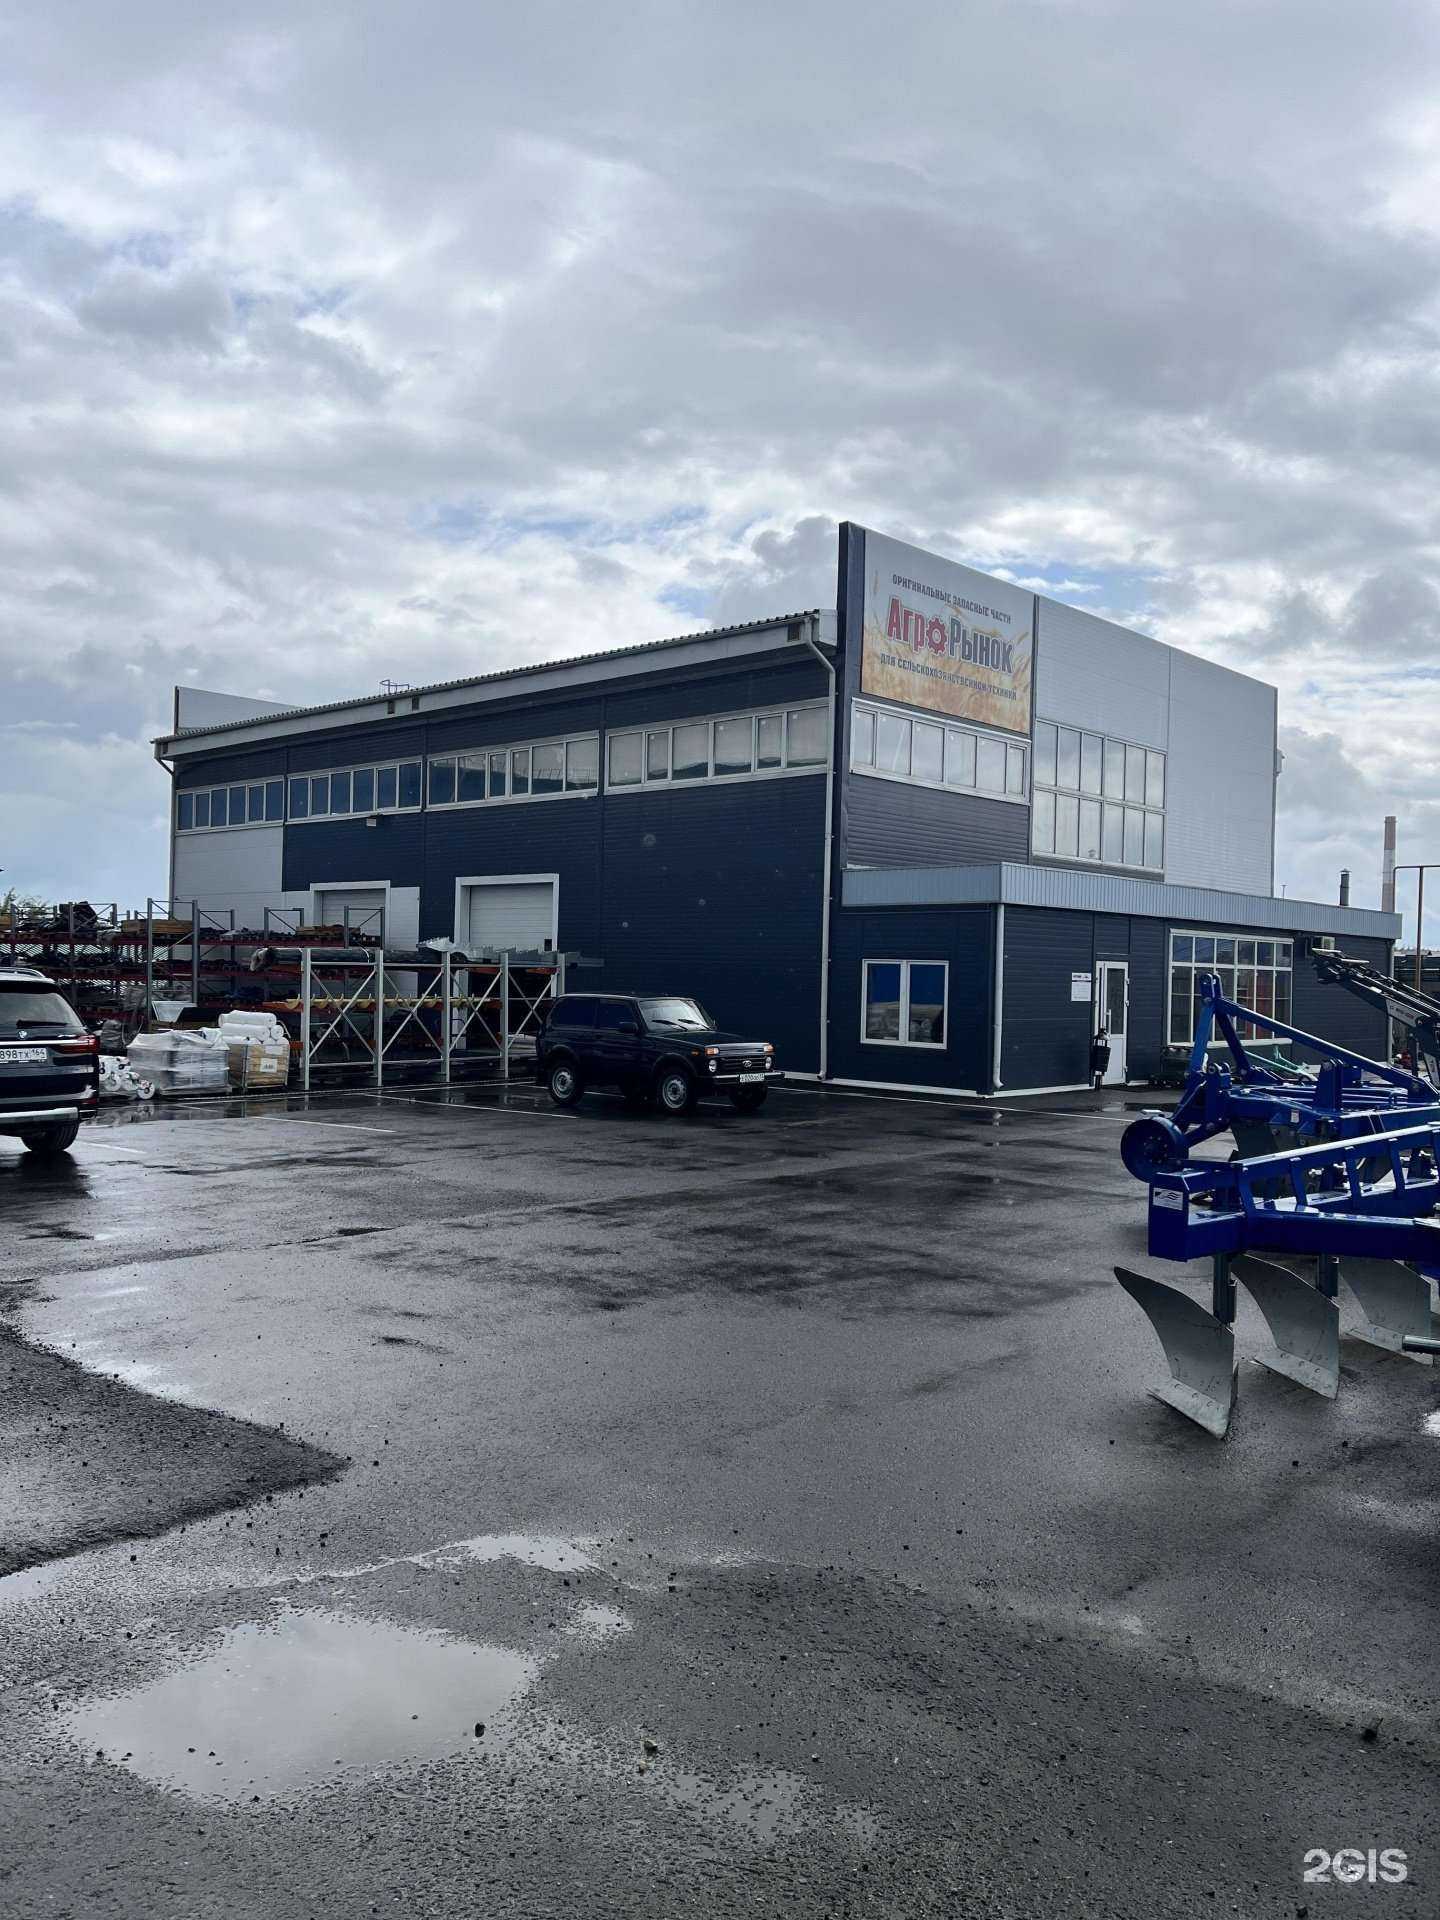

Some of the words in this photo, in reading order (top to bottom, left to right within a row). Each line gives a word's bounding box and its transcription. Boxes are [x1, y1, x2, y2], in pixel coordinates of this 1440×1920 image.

[892, 574, 951, 604] ОРИГИНАЛЬНЫЕ
[953, 595, 989, 617] ЗАПАСНЫЕ
[991, 610, 1011, 624] ЧАСТИ
[880, 653, 896, 667] ДЛЯ
[897, 658, 987, 693] СЕЛЬСКОХОЗЯЙСТВЕННОЙ
[988, 687, 1017, 701] ТЕХНИКИ
